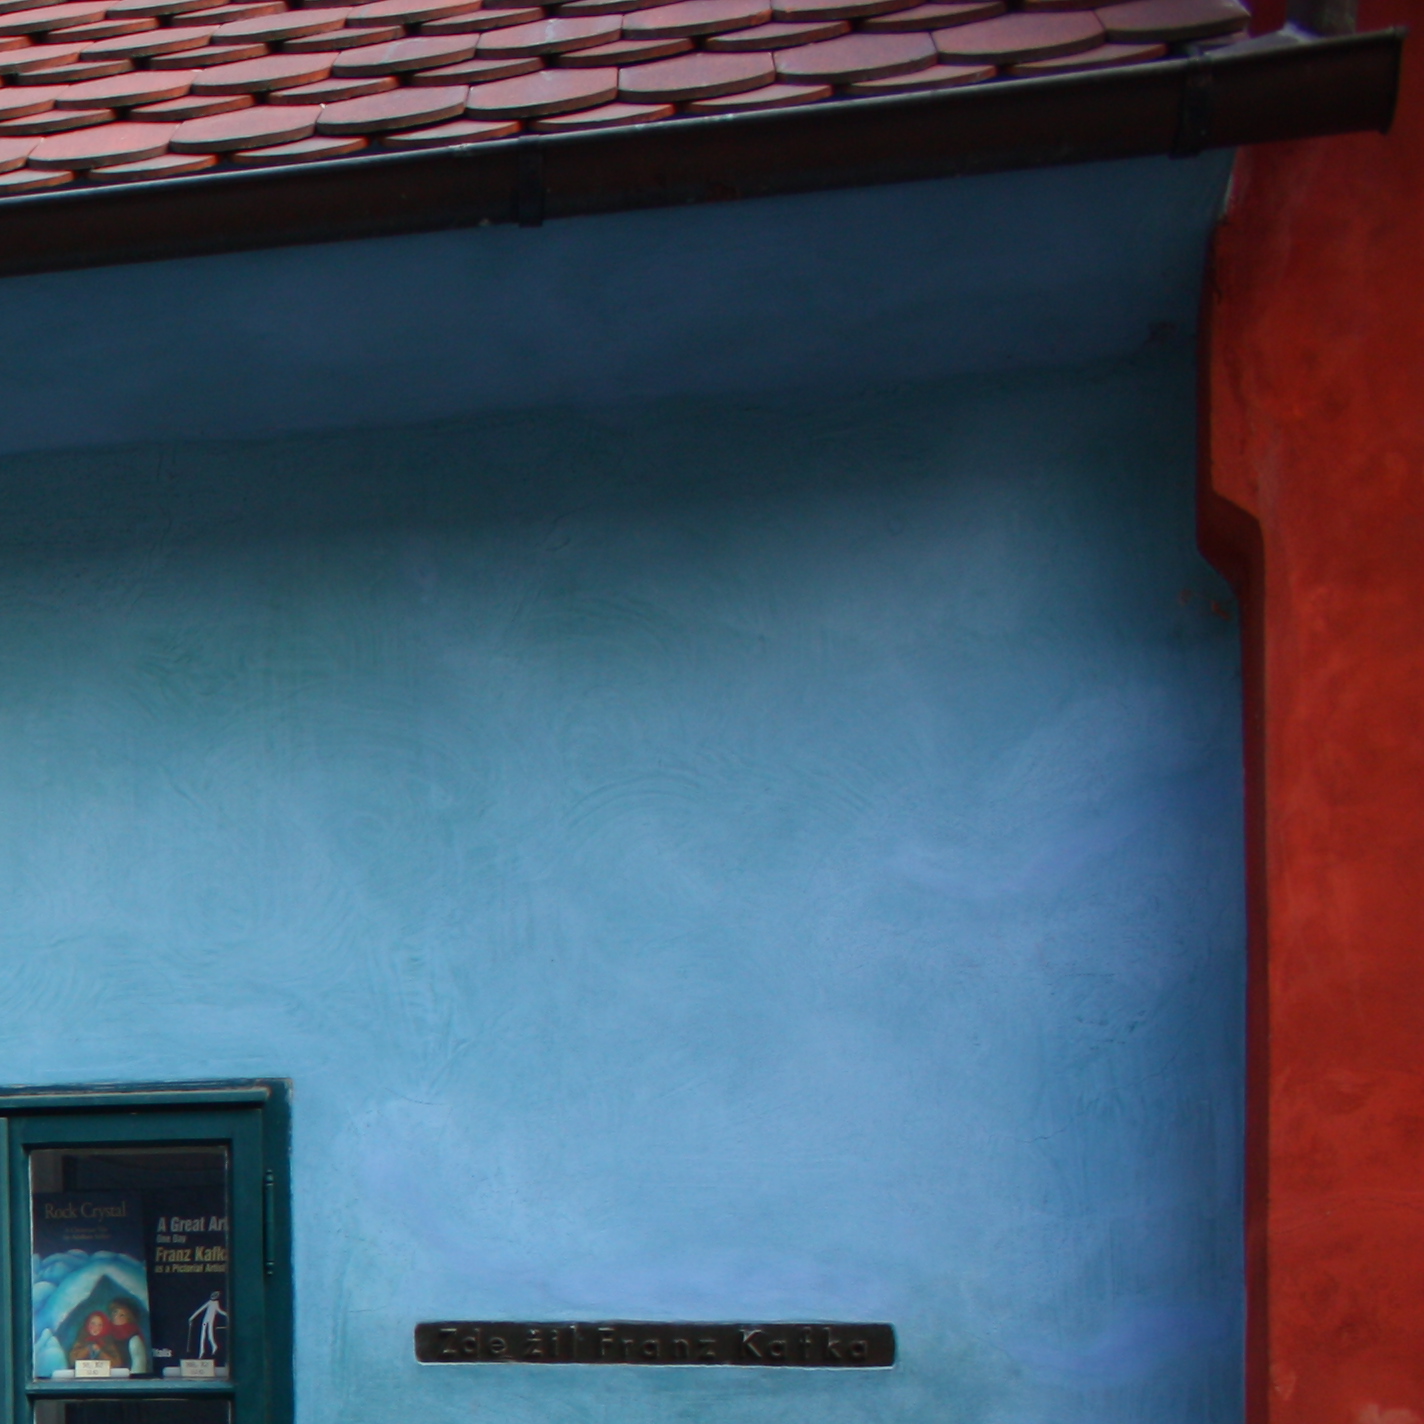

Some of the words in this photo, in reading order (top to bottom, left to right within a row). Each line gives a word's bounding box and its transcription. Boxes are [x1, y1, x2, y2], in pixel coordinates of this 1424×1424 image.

[44, 1202, 78, 1220] Rock
[80, 1200, 127, 1221] Crystal
[156, 1217, 167, 1233] A
[170, 1216, 205, 1232] Great
[172, 1234, 187, 1245] Day
[155, 1246, 191, 1263] Franz
[439, 1326, 508, 1358] Zde
[524, 1323, 579, 1359] žil
[596, 1326, 718, 1360] Franz
[739, 1326, 871, 1360] Kafka
